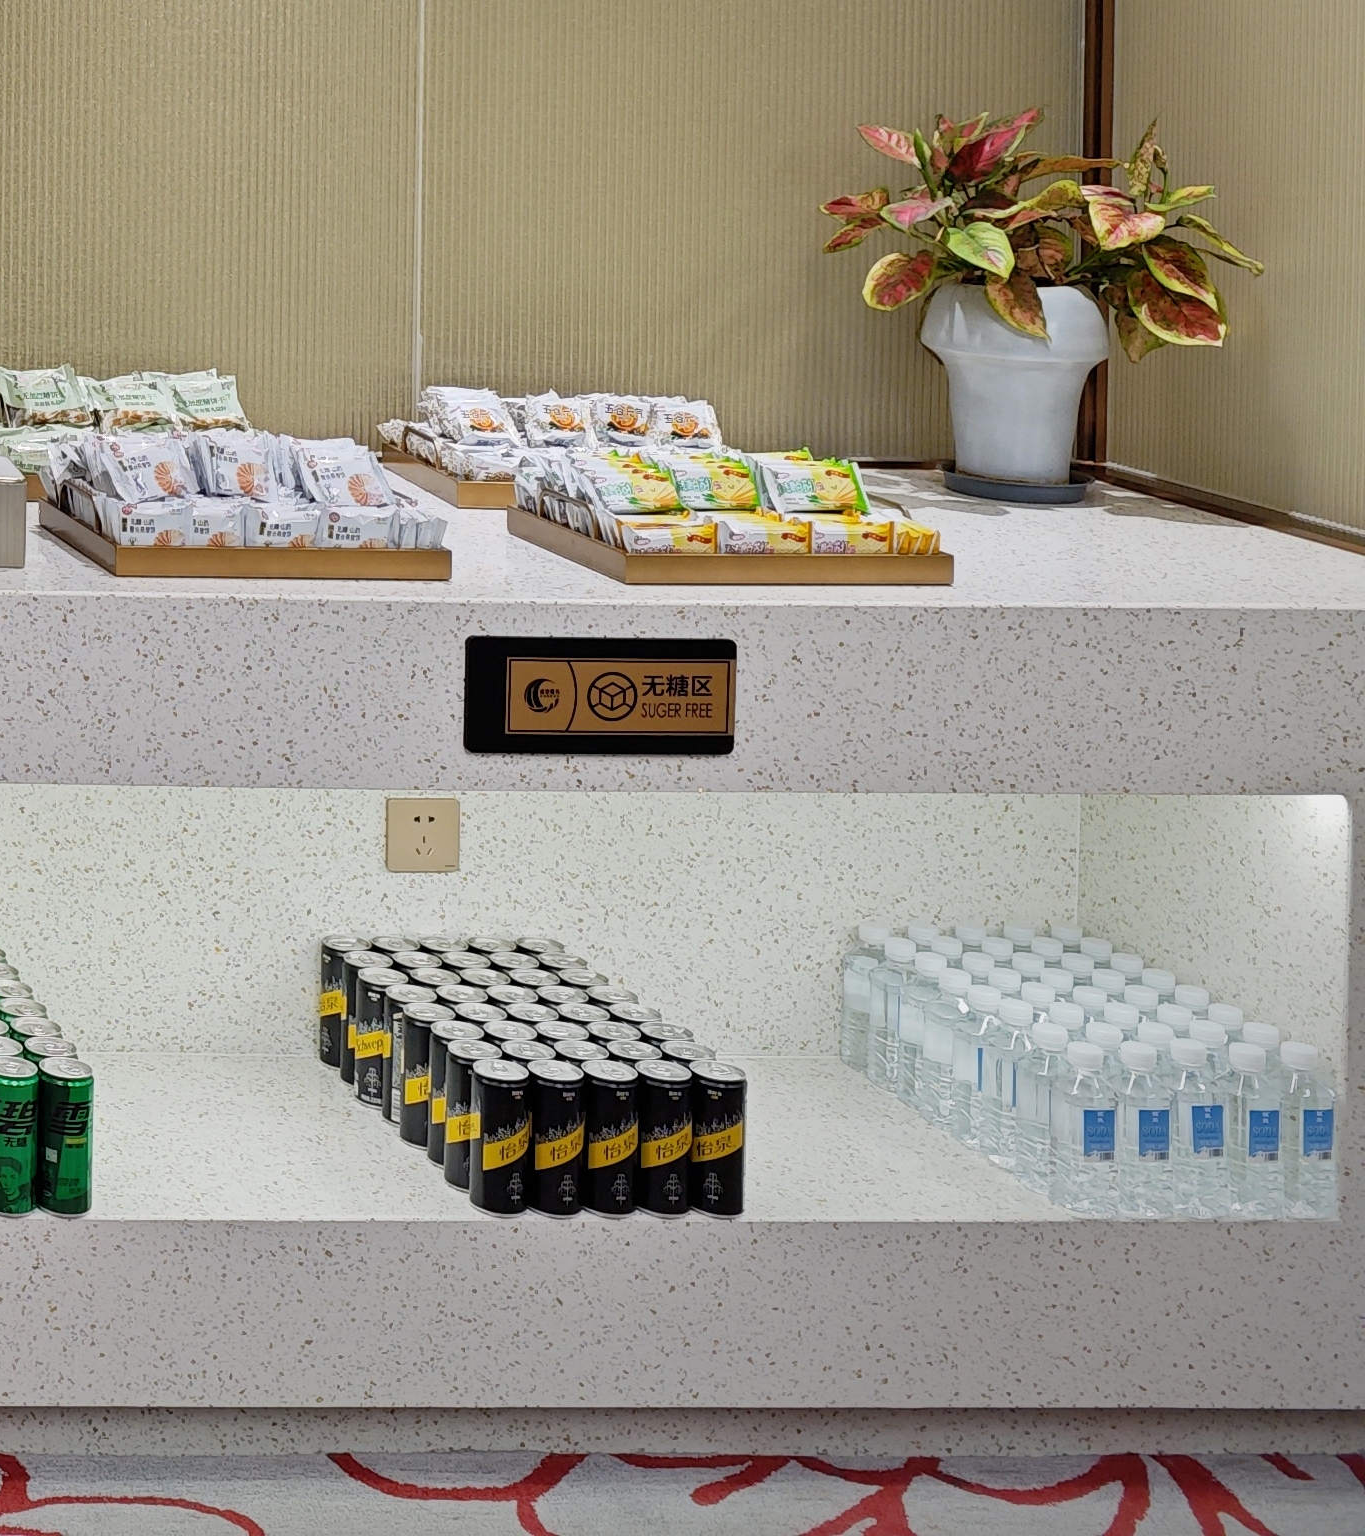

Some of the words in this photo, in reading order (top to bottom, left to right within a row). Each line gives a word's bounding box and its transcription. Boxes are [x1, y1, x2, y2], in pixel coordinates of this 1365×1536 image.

[641, 674, 713, 698] 无糖区
[641, 702, 682, 719] SUGER
[685, 703, 713, 719] FREE
[655, 1132, 690, 1161] 怡泉
[696, 1134, 732, 1158] 怡泉
